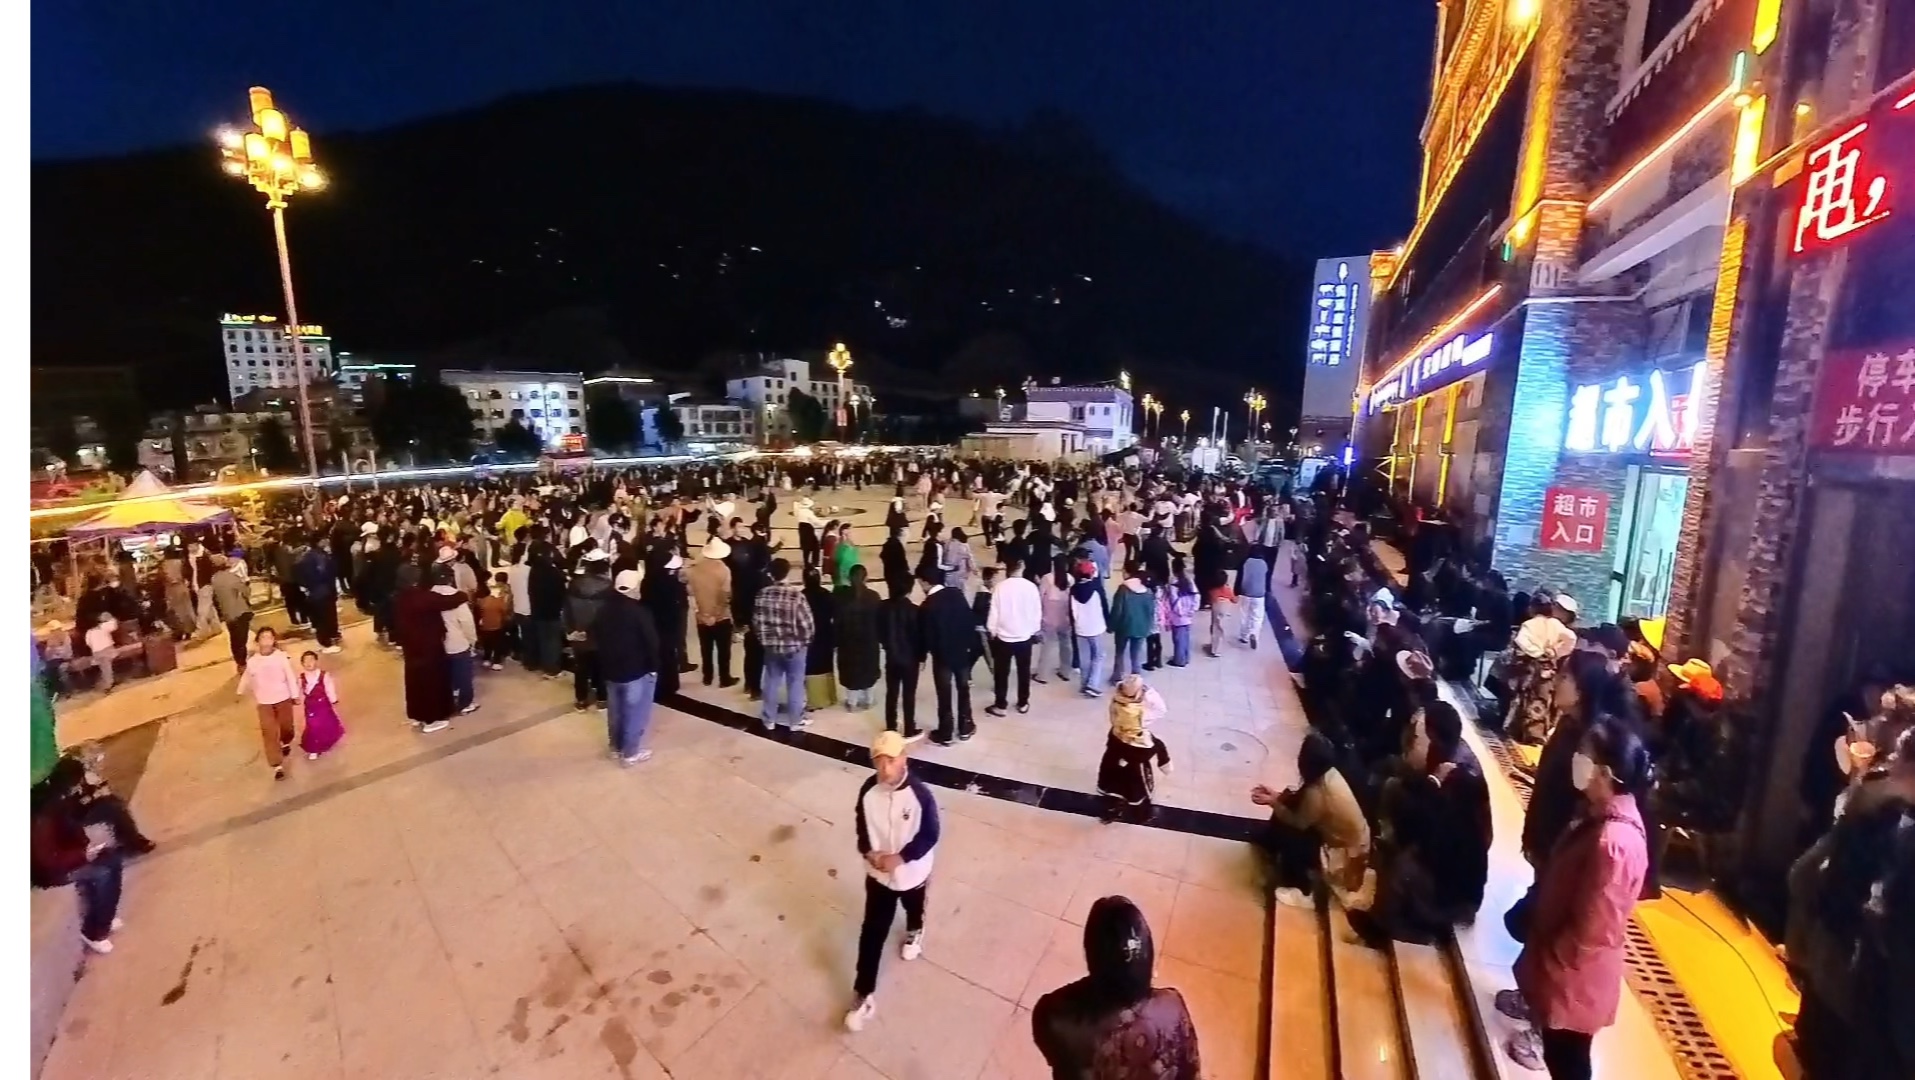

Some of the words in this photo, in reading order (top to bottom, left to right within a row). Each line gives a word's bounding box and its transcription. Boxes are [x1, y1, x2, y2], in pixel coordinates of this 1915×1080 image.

[1564, 360, 1708, 452] 超市入
[1553, 493, 1599, 518] 超市
[1550, 520, 1594, 544] 入口
